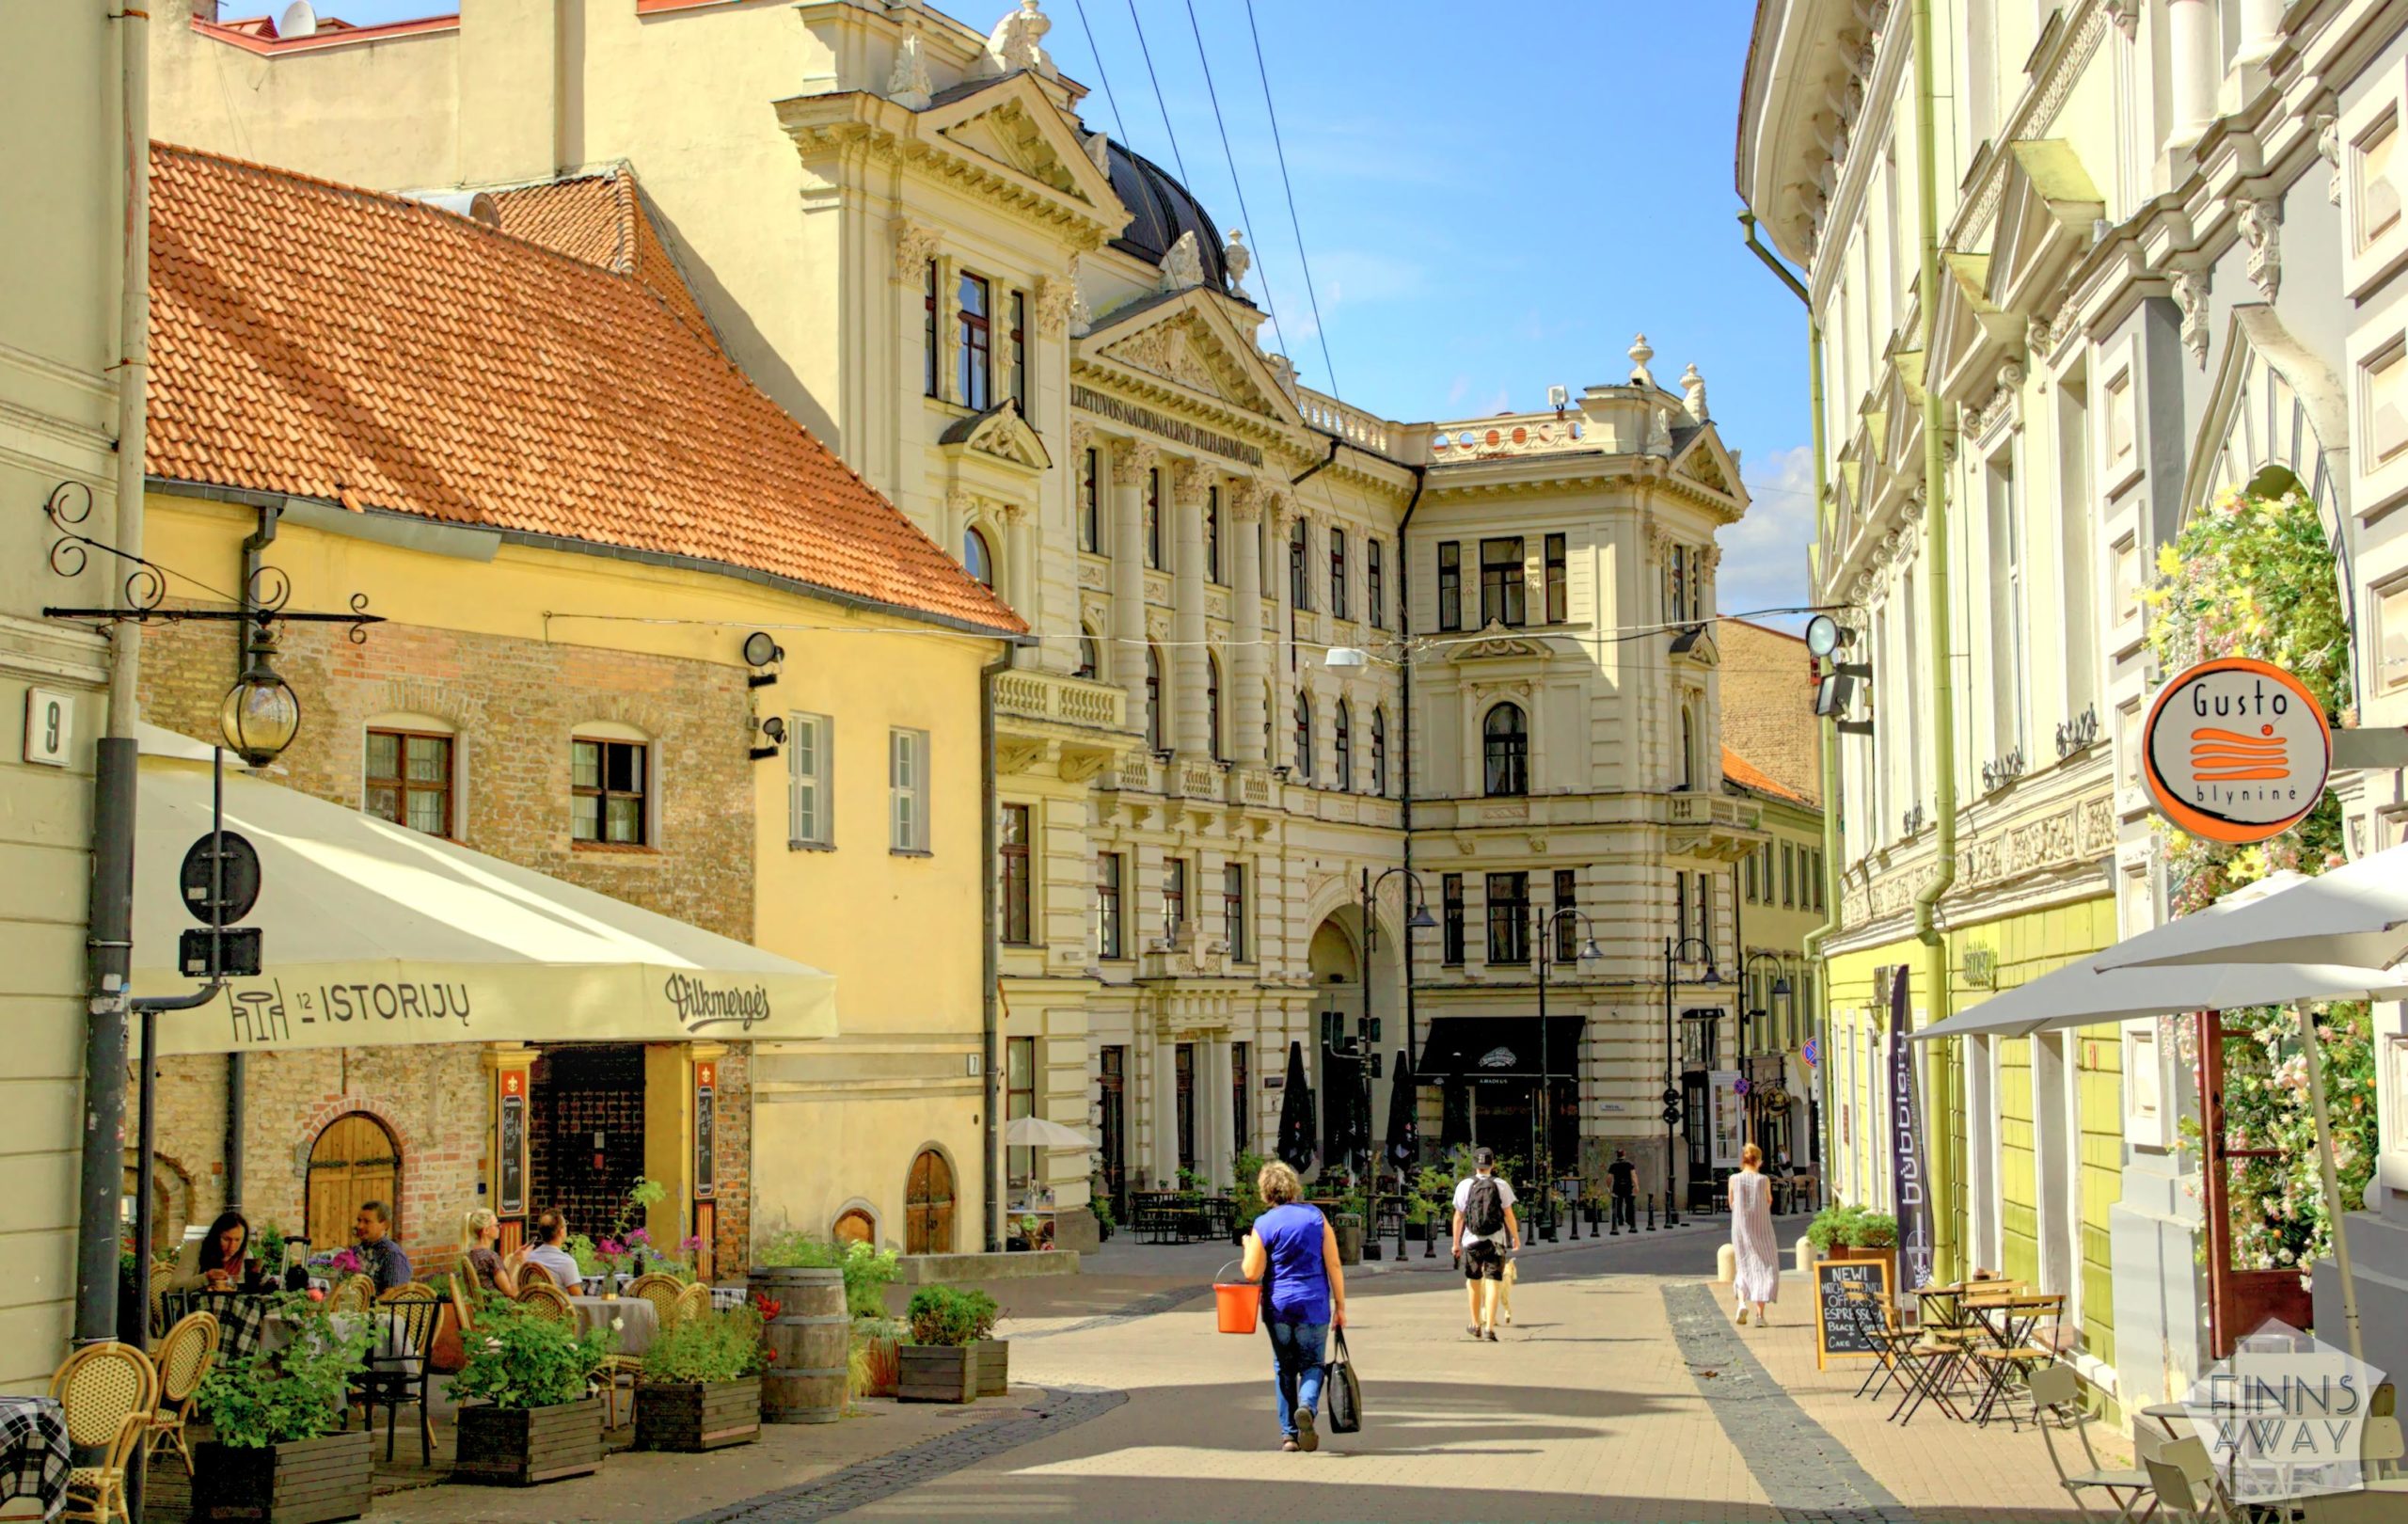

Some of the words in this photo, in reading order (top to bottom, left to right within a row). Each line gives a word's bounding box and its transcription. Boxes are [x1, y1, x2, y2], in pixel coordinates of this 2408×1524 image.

[1069, 384, 1123, 421] LIETUVOS
[2194, 680, 2288, 717] Gusto
[46, 701, 60, 754] 9
[2197, 785, 2296, 805] blyninė
[296, 992, 312, 1010] 12
[320, 983, 470, 1026] ISTORIJŲ
[665, 972, 769, 1033] Vilkmergės
[1832, 1266, 1868, 1281] NEW!
